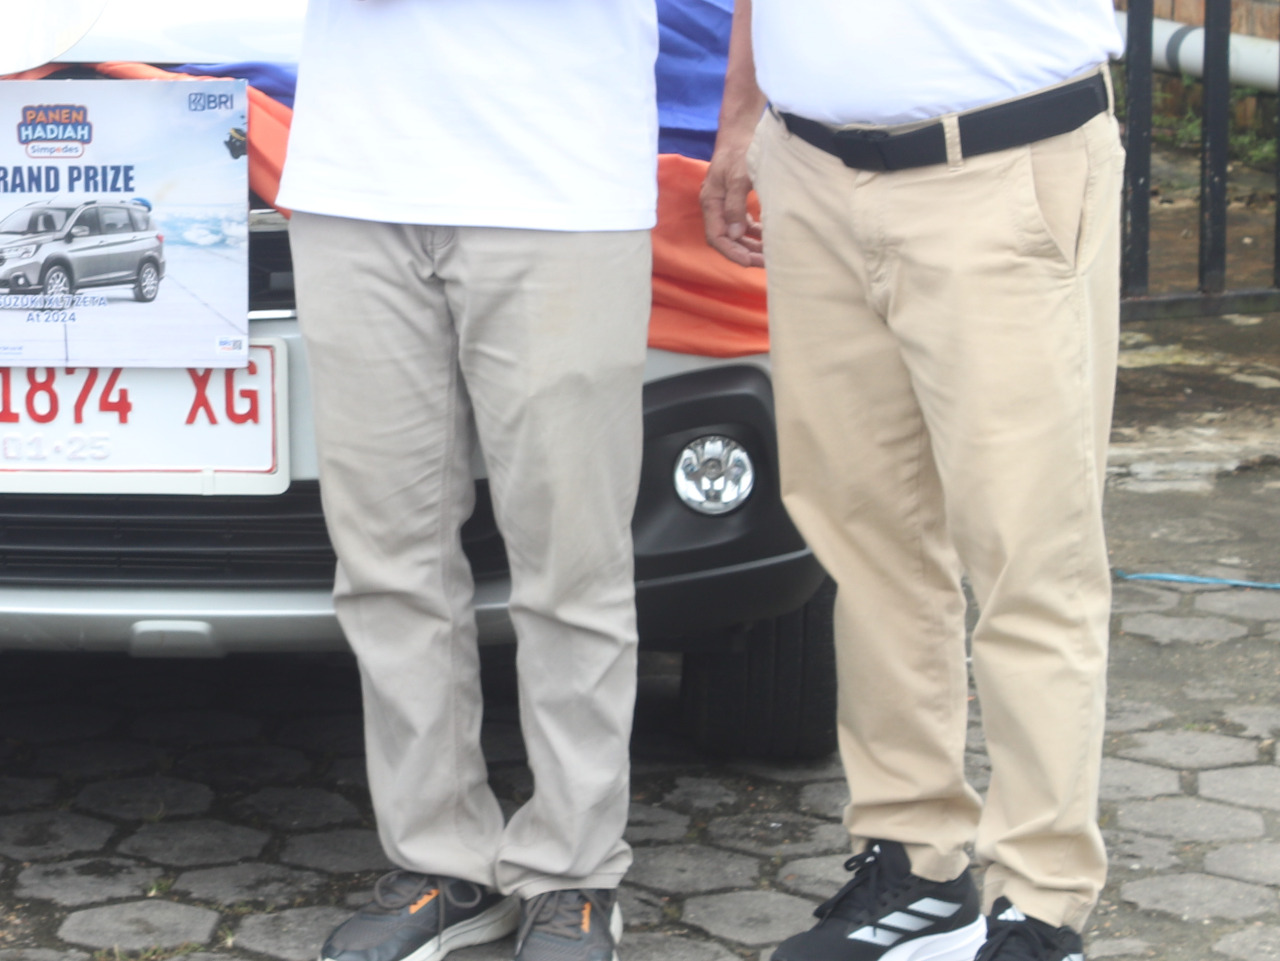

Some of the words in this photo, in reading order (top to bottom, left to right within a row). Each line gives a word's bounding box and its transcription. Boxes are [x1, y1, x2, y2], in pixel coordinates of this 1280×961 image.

[206, 93, 235, 110] BRI
[25, 108, 84, 125] PANEN
[20, 123, 89, 141] HADIAH
[30, 144, 80, 155] Simpedes
[67, 165, 136, 193] PRIZE
[73, 295, 109, 308] ZETA
[44, 311, 77, 323] 2024
[184, 359, 260, 425] XG
